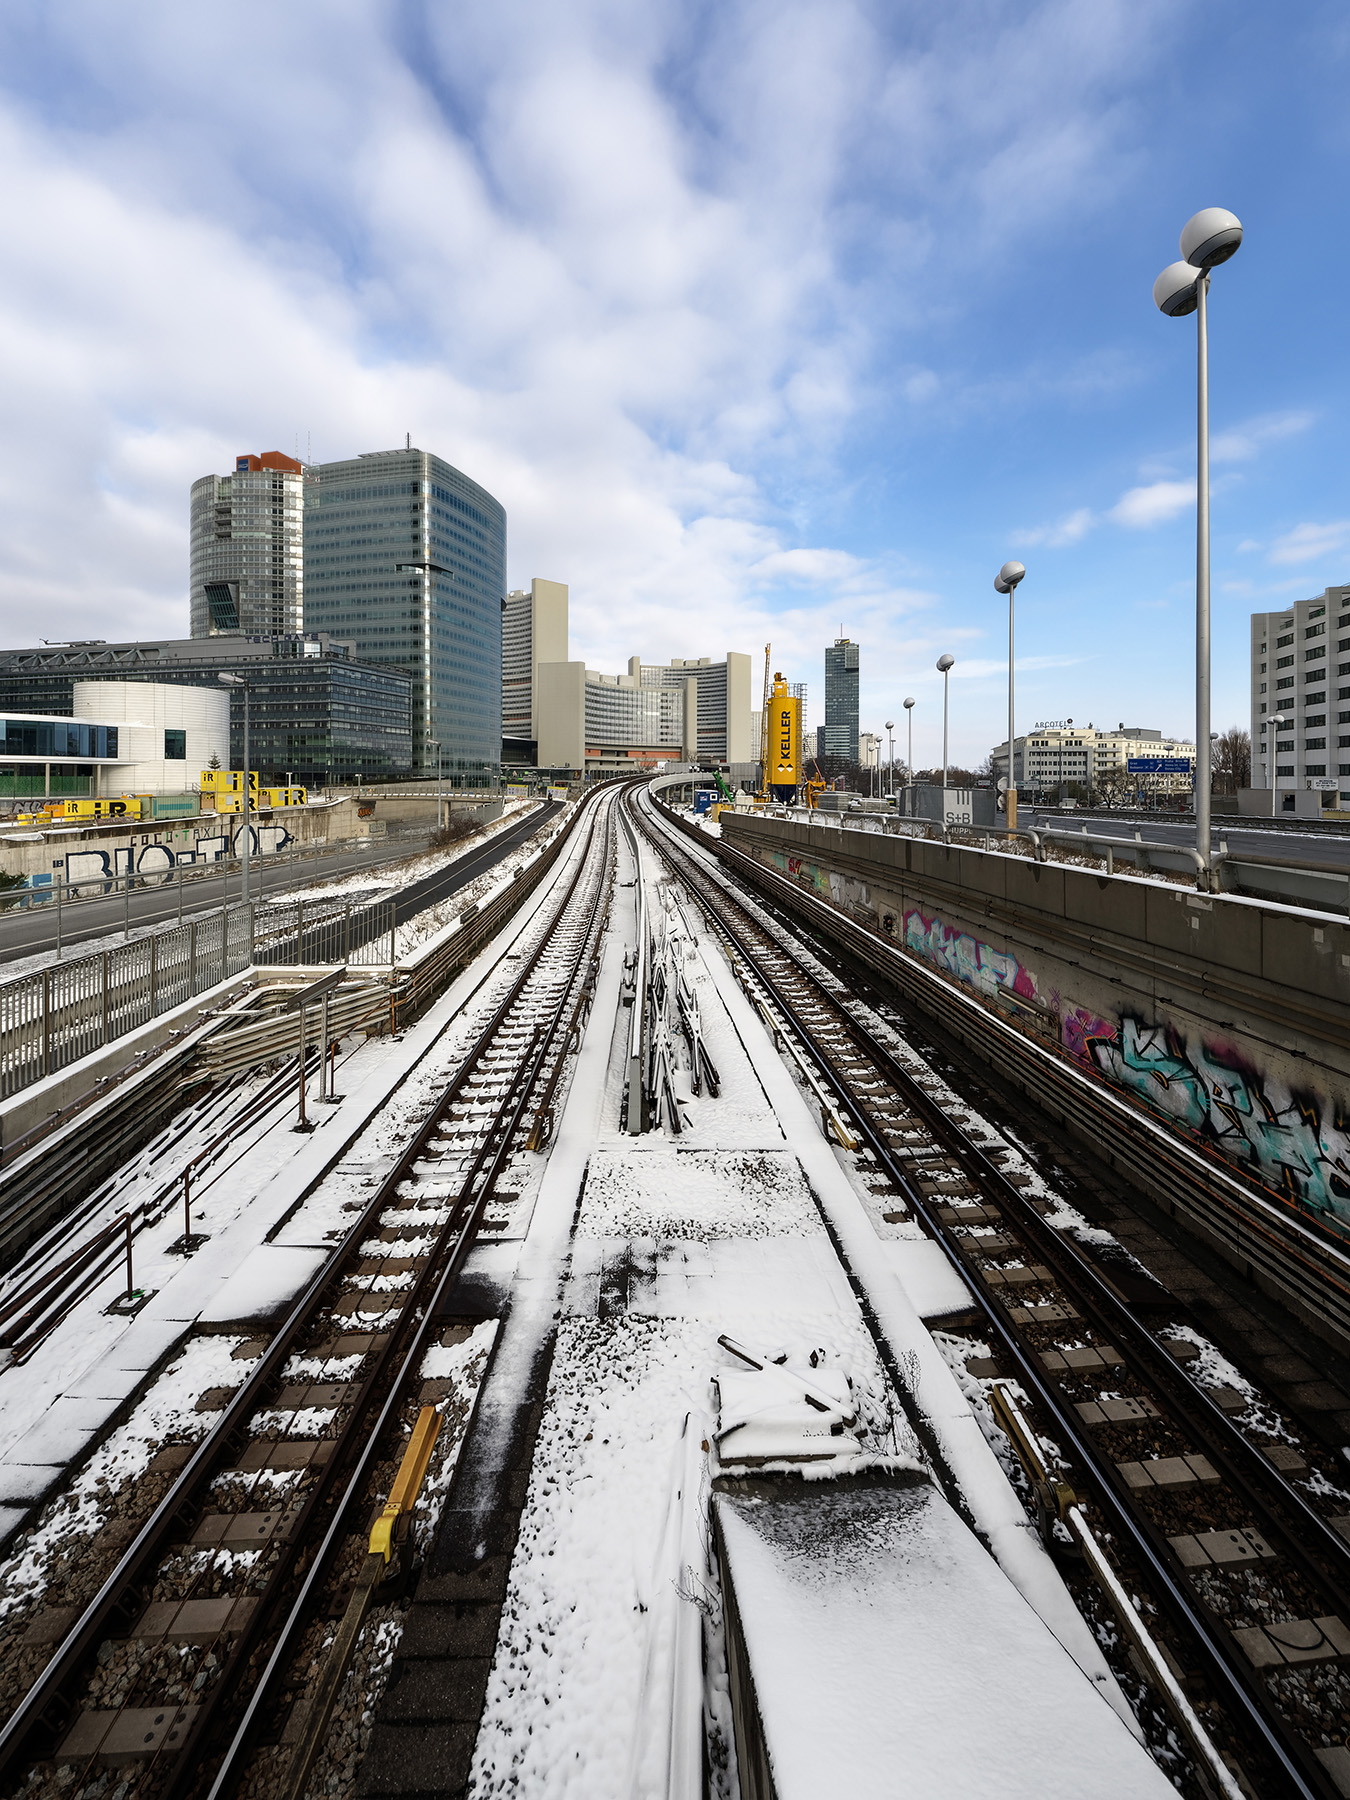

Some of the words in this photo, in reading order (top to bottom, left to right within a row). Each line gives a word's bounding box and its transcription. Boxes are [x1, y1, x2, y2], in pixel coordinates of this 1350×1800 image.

[245, 635, 278, 644] TECH
[781, 711, 790, 759] KELLER
[68, 804, 78, 813] iR
[946, 812, 970, 824] S+B
